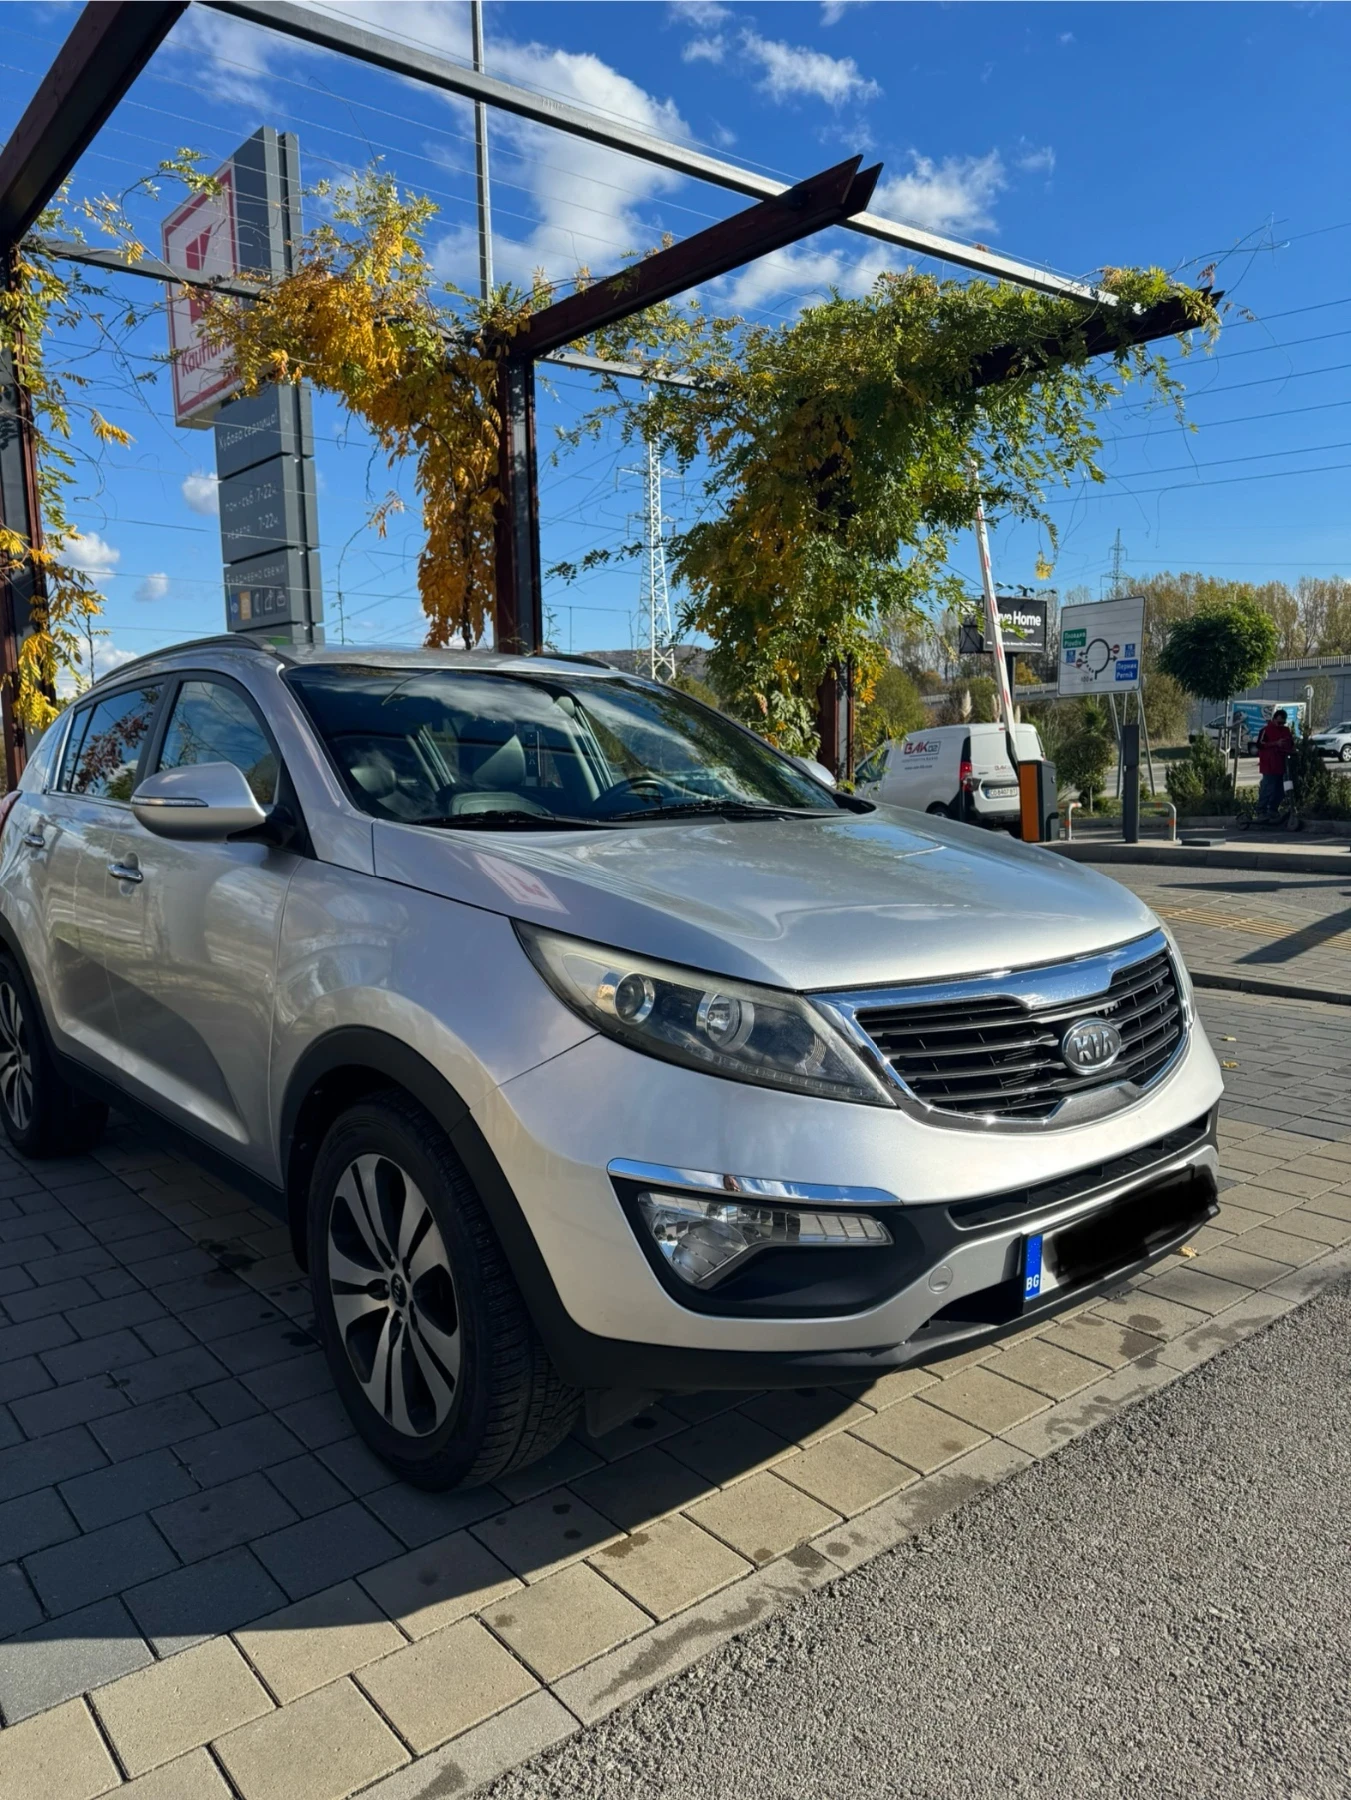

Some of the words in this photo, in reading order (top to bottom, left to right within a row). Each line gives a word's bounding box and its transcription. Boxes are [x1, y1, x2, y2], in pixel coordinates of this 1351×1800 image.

[1013, 610, 1042, 627] Home
[1116, 662, 1137, 671] Перник
[1116, 671, 1134, 679] Pernik
[1074, 1030, 1115, 1062] KIA
[1026, 1274, 1040, 1290] BG
